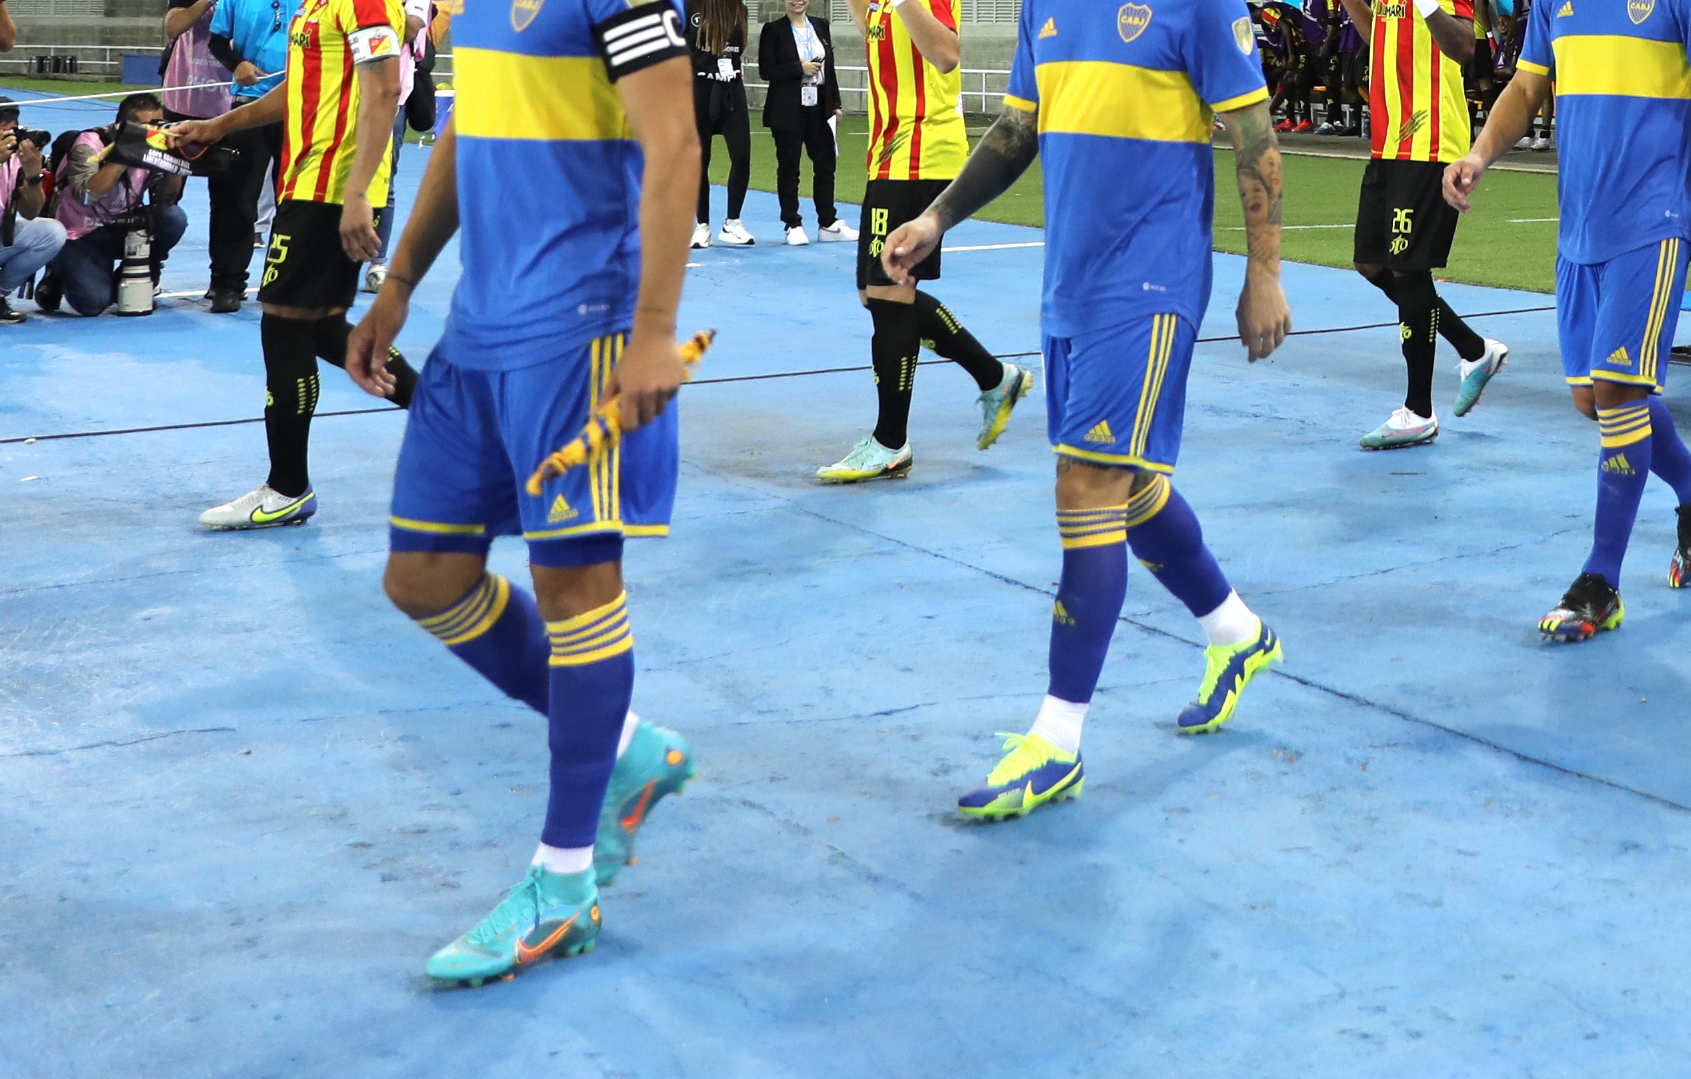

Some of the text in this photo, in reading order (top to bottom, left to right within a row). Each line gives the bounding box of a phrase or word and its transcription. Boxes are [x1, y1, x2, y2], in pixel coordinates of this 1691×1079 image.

[1121, 15, 1146, 25] CABJ
[871, 207, 889, 236] 18
[1391, 207, 1414, 234] 26
[267, 233, 291, 264] 25
